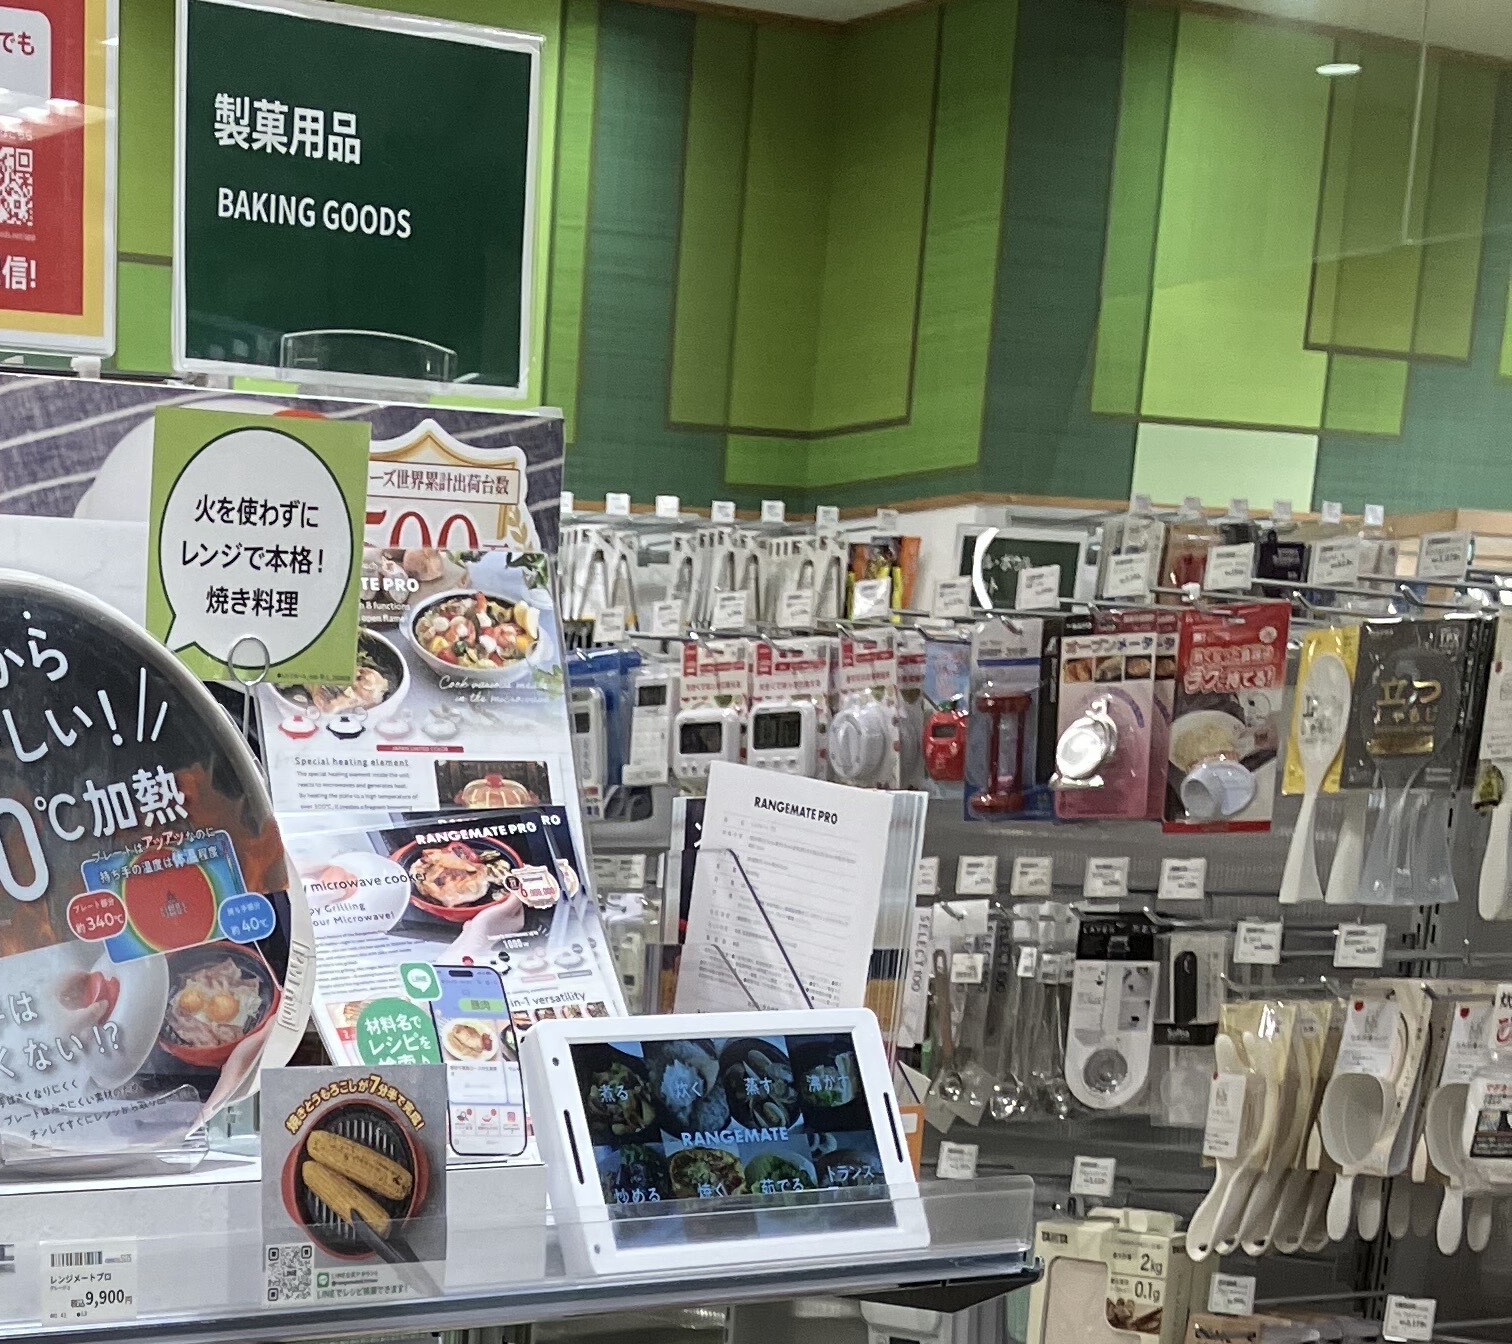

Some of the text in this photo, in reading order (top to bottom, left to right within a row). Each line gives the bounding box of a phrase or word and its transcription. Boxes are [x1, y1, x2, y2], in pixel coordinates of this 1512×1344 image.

[213, 92, 362, 166] 製菓用品
[217, 187, 412, 240] BAKING GOODS
[194, 494, 319, 530] 火を使わずに
[382, 576, 420, 593] PRO
[205, 584, 300, 620] 焼き料理
[294, 757, 410, 768] Special heating element
[754, 796, 838, 825] RANGEMATE PRO
[416, 821, 537, 845] RANGEMATE PRO
[312, 871, 427, 893] microwave cooker
[325, 902, 366, 913] Grilling
[533, 991, 586, 1007] versatility
[364, 1012, 422, 1036] 材料名で
[367, 1034, 432, 1056] レシピを
[599, 1082, 629, 1102] 煮る
[744, 1076, 774, 1096] 蒸す
[681, 1126, 790, 1148] RANGEMATE
[1140, 1253, 1163, 1276] 2kg
[50, 1272, 112, 1284] レンジメートプロ
[1134, 1280, 1161, 1302] 0.1g
